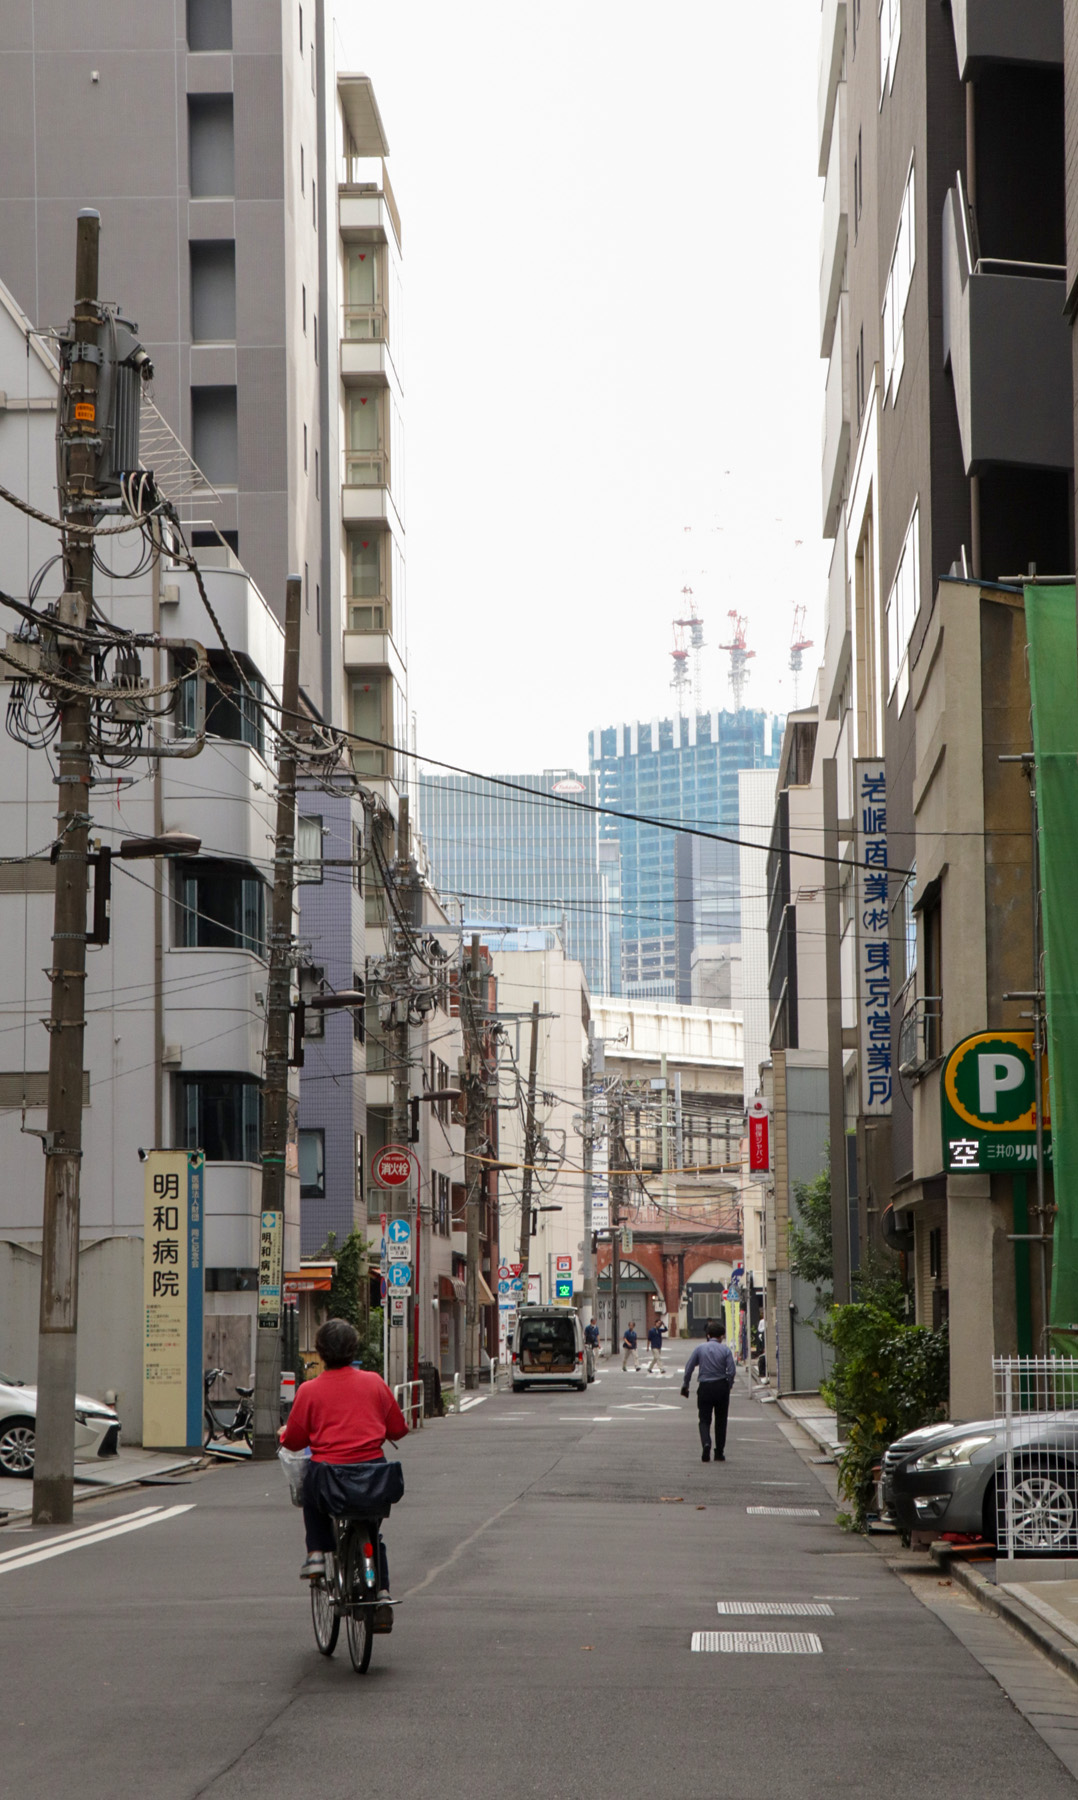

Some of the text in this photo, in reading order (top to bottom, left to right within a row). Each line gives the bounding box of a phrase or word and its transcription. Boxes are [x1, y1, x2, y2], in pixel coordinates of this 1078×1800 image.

[861, 771, 893, 1105] 岩崎商業(株東京営業所
[977, 1053, 1026, 1113] P
[381, 1162, 409, 1176] 消火栓
[949, 1138, 980, 1168] 空
[986, 1144, 1053, 1161] 三井のリパ
[152, 1173, 180, 1297] 明和病院
[260, 1232, 272, 1285] 明和病院
[393, 1268, 402, 1284] P
